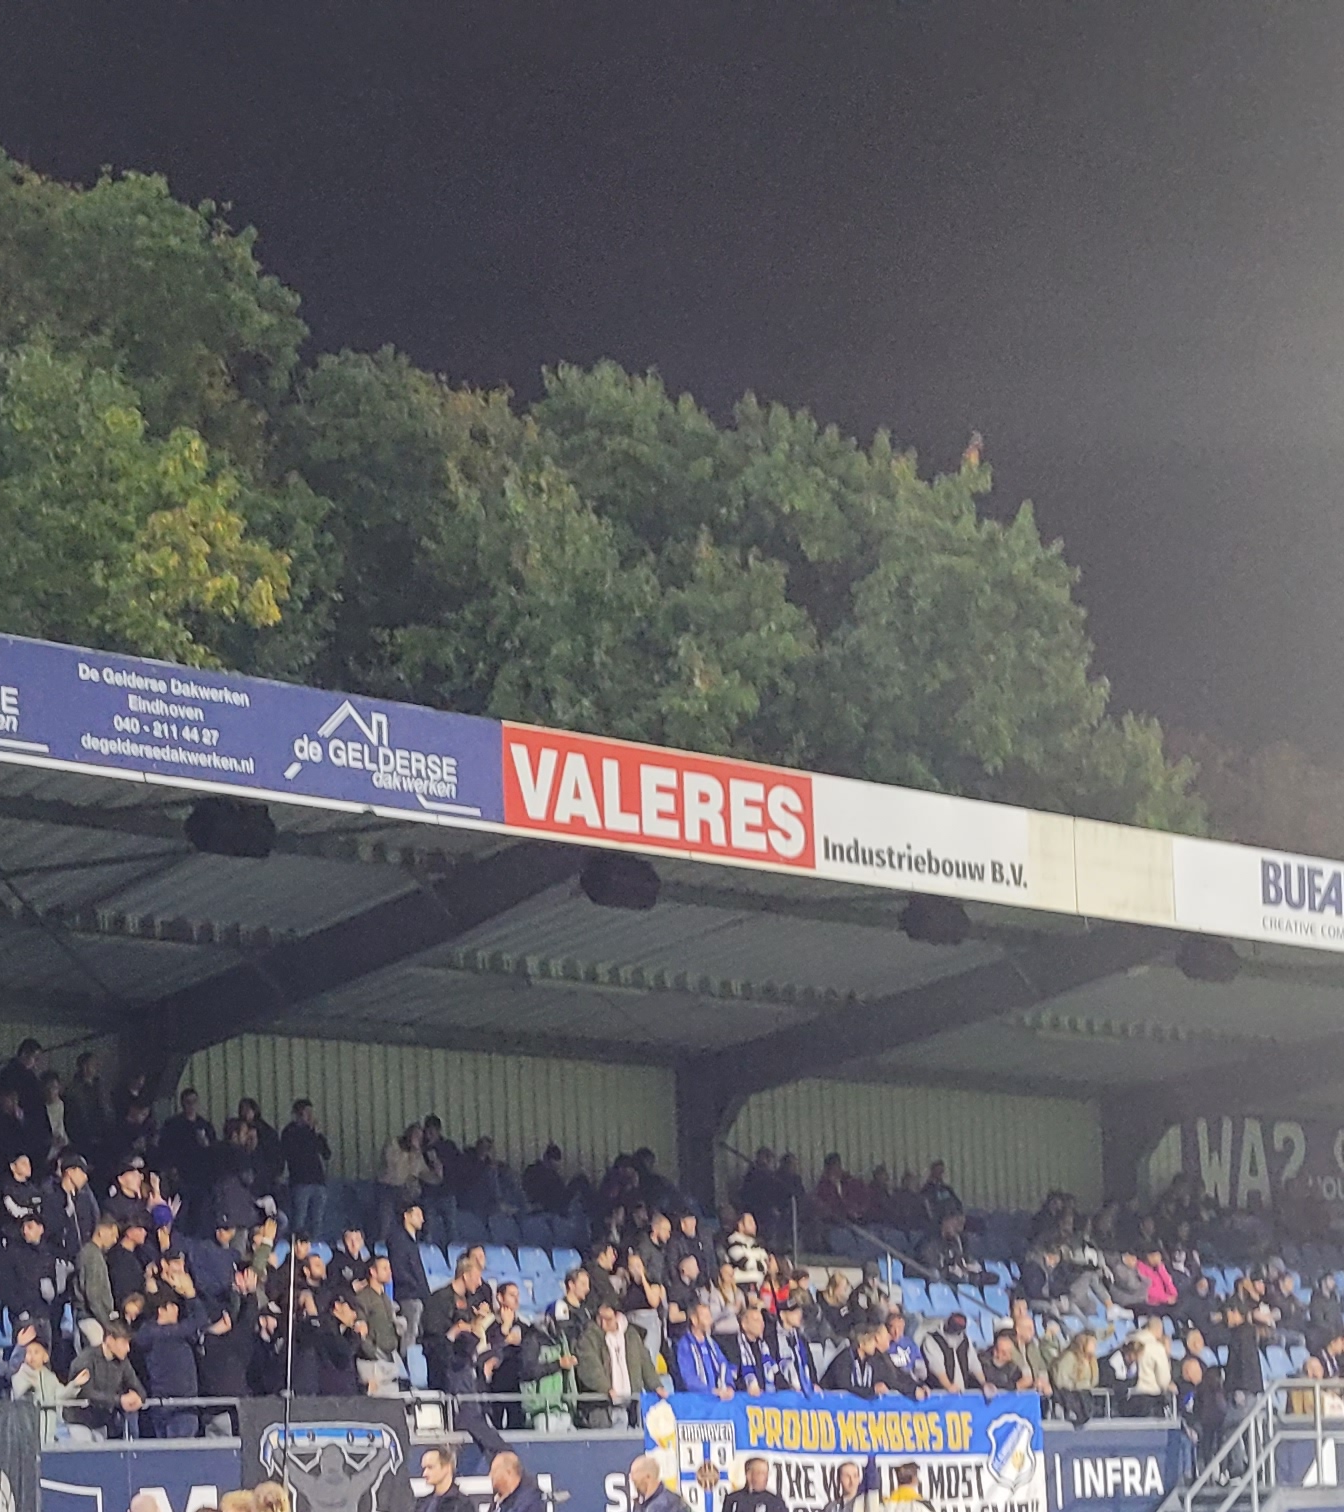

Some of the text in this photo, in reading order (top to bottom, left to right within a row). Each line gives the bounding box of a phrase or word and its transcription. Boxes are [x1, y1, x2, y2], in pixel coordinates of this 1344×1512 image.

[78, 662, 250, 707] De Gelderse Dakwerken
[128, 693, 205, 721] Eindhoven
[113, 714, 140, 734] 040
[182, 725, 200, 744] 44
[202, 728, 220, 747] 27
[81, 733, 255, 775] degeldersedakwerken.nl
[294, 734, 458, 784] de GELDERSE
[372, 771, 457, 799] dakwerken
[510, 742, 806, 860] VALERES
[823, 835, 1028, 888] Industriebouw B.V.
[1262, 915, 1317, 937] CREATIVE
[746, 1405, 973, 1452] PROUD MEMBERS OF
[927, 1463, 984, 1500] MOST
[1073, 1456, 1165, 1498] INFRA
